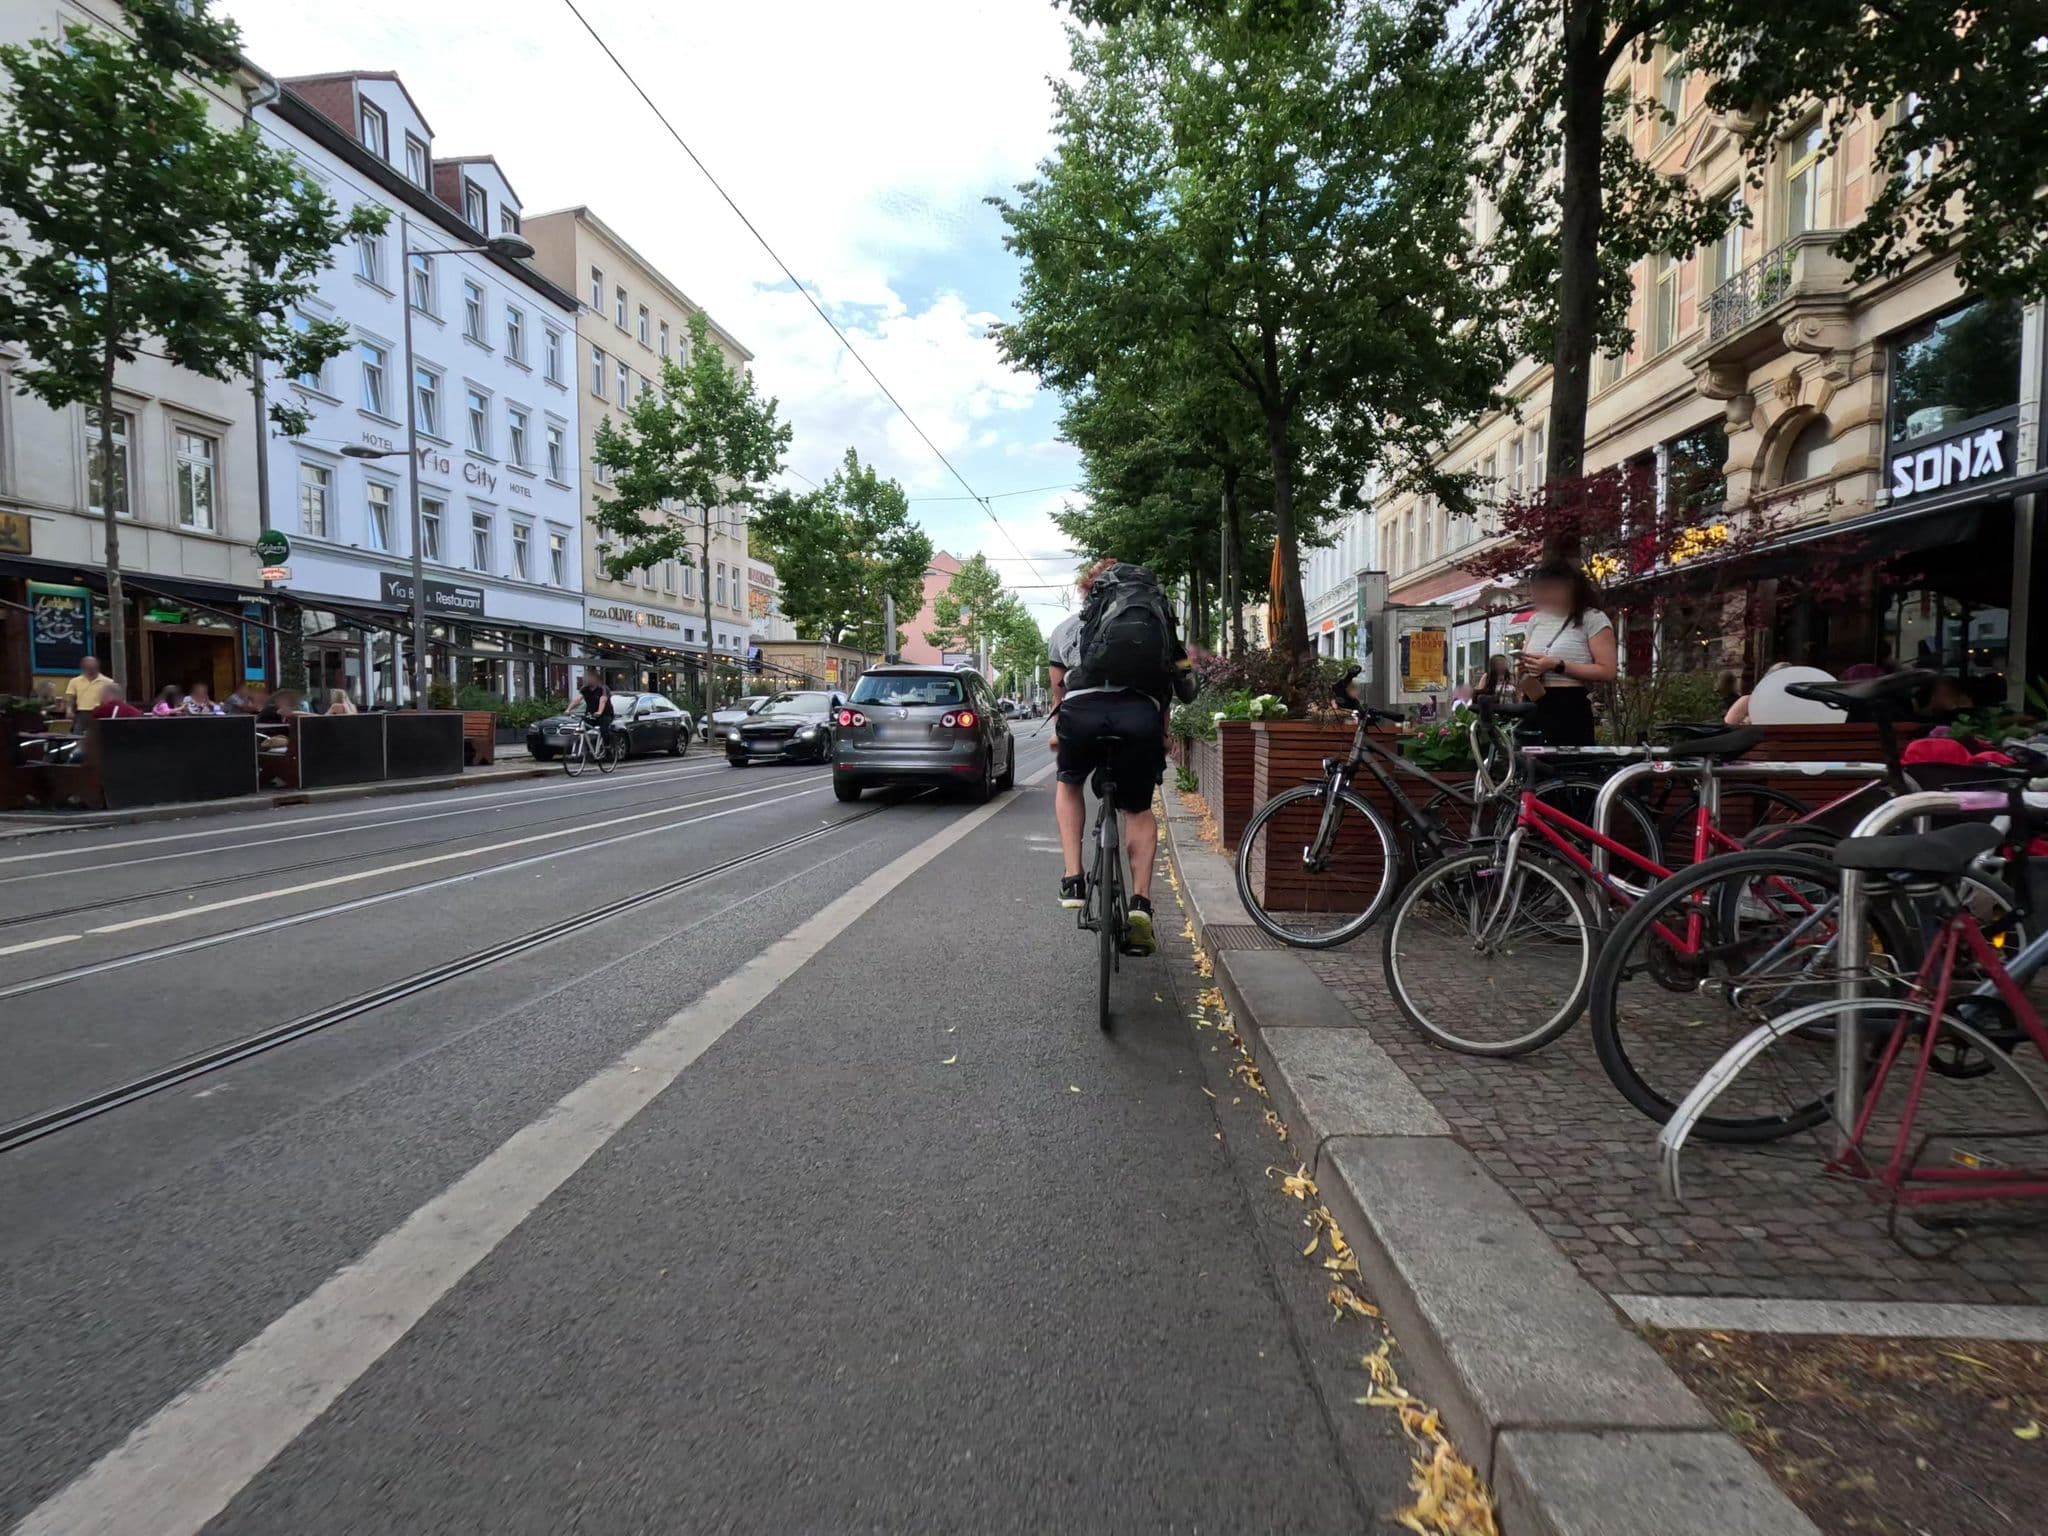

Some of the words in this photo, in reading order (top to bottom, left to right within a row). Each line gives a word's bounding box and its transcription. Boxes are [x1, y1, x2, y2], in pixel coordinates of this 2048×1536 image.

[362, 431, 393, 450] HOTEL
[463, 462, 497, 494] City
[510, 483, 533, 498] HOTEL
[1892, 428, 2004, 498] SONA
[435, 591, 481, 609] Restaurant
[589, 608, 607, 619] PIZZA
[608, 606, 634, 623] OLIVE
[646, 613, 666, 629] TREE
